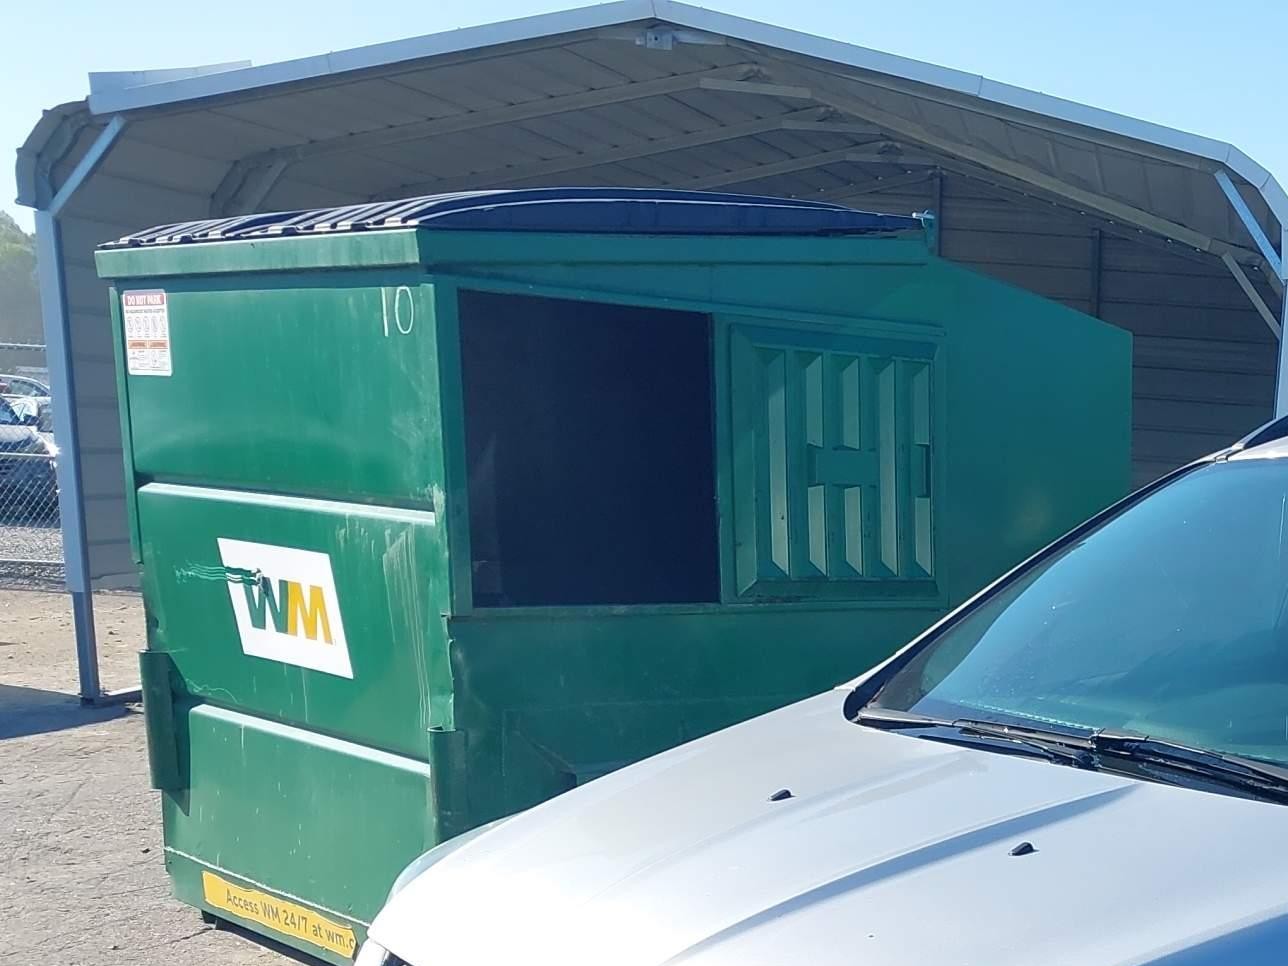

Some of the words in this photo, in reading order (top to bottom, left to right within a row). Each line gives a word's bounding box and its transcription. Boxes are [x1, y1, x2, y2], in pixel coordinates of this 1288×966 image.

[127, 295, 136, 306] DO
[381, 286, 414, 337] 10
[243, 575, 334, 646] WM
[226, 889, 259, 915] Access
[260, 901, 281, 923] WM
[282, 910, 308, 934] 24/7
[311, 923, 324, 939] at
